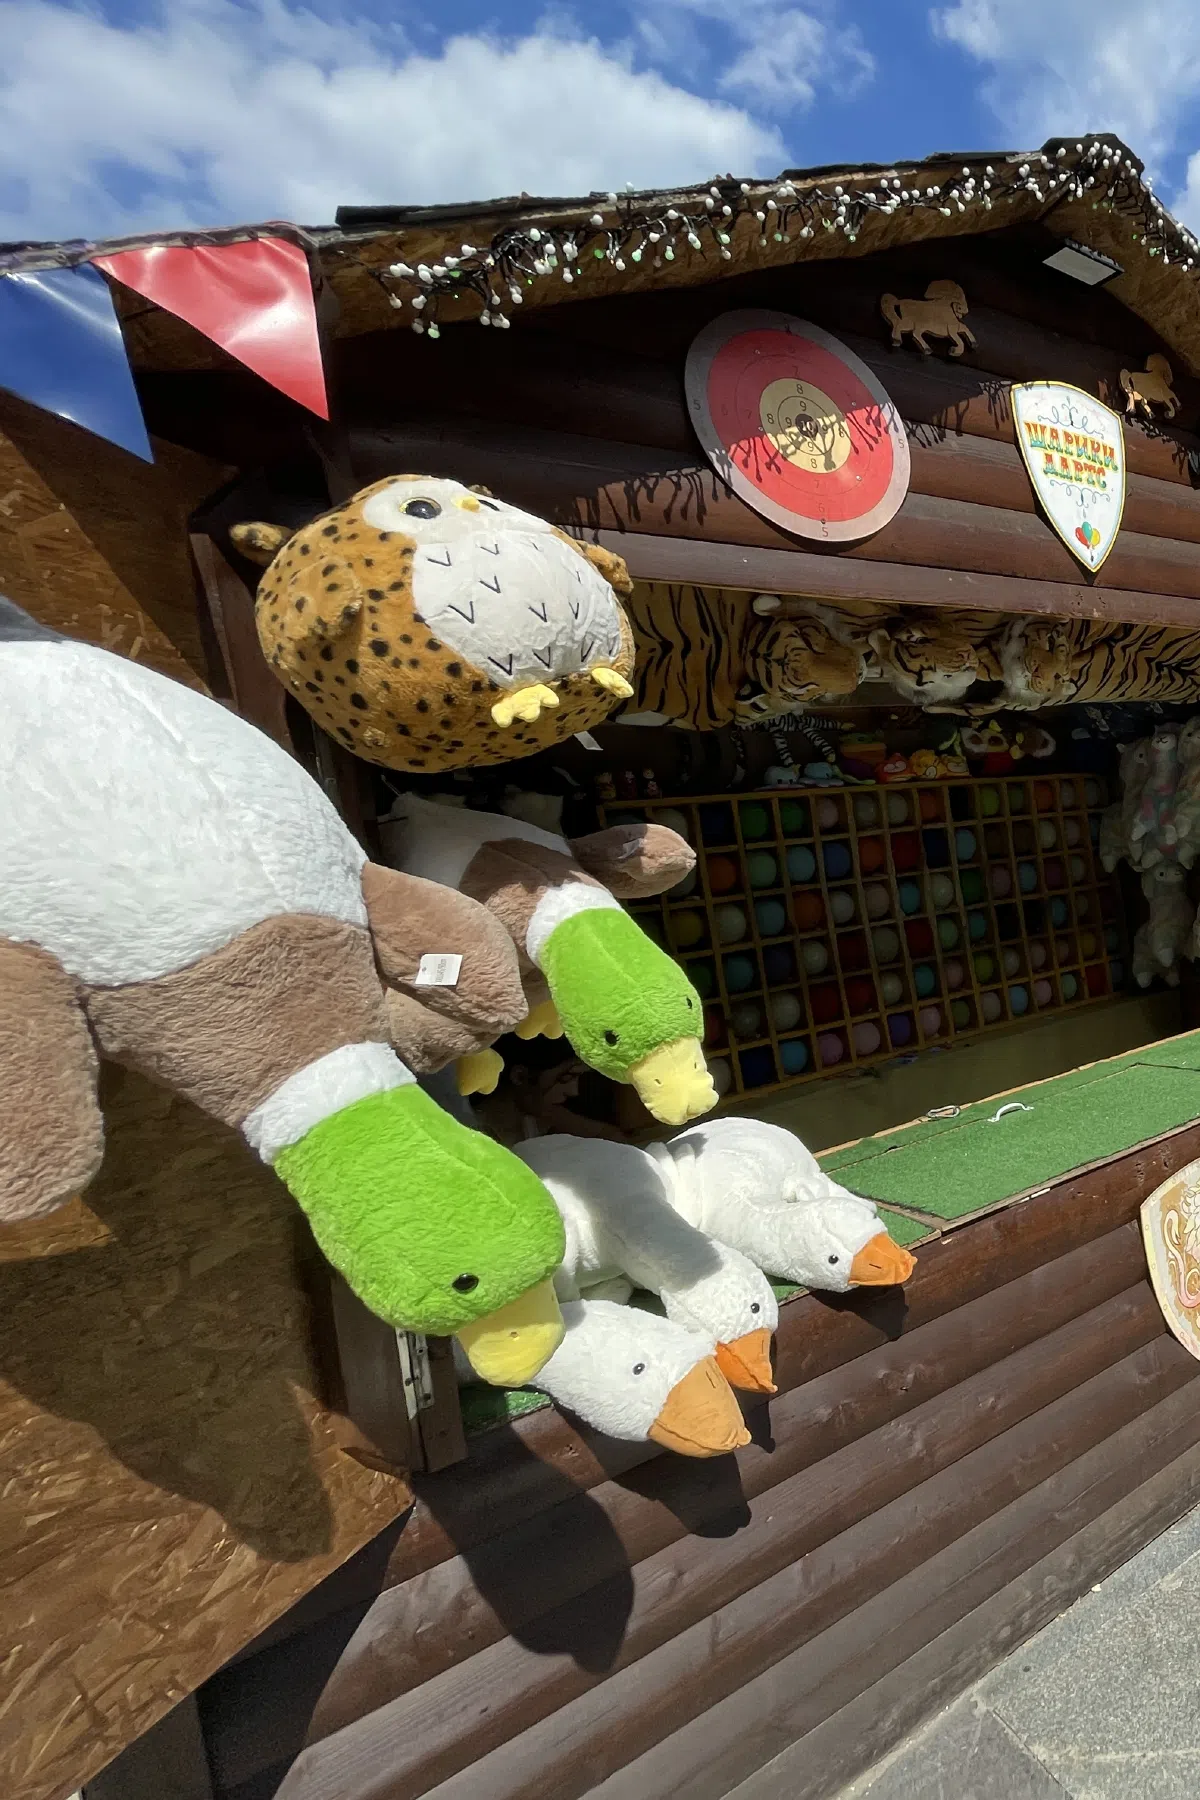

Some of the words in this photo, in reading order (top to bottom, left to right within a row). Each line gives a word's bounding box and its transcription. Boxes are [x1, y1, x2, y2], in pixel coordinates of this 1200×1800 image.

[796, 383, 804, 395] 8
[693, 398, 702, 411] 5
[799, 400, 807, 412] 9
[766, 413, 775, 425] 8
[785, 416, 793, 428] 9
[800, 420, 815, 432] 10
[807, 441, 815, 453] 9
[897, 438, 905, 449] 5
[1023, 421, 1119, 472] ШАРИКИ
[810, 457, 818, 469] 8
[1043, 452, 1107, 489] ДАРТС
[821, 526, 829, 538] 5
